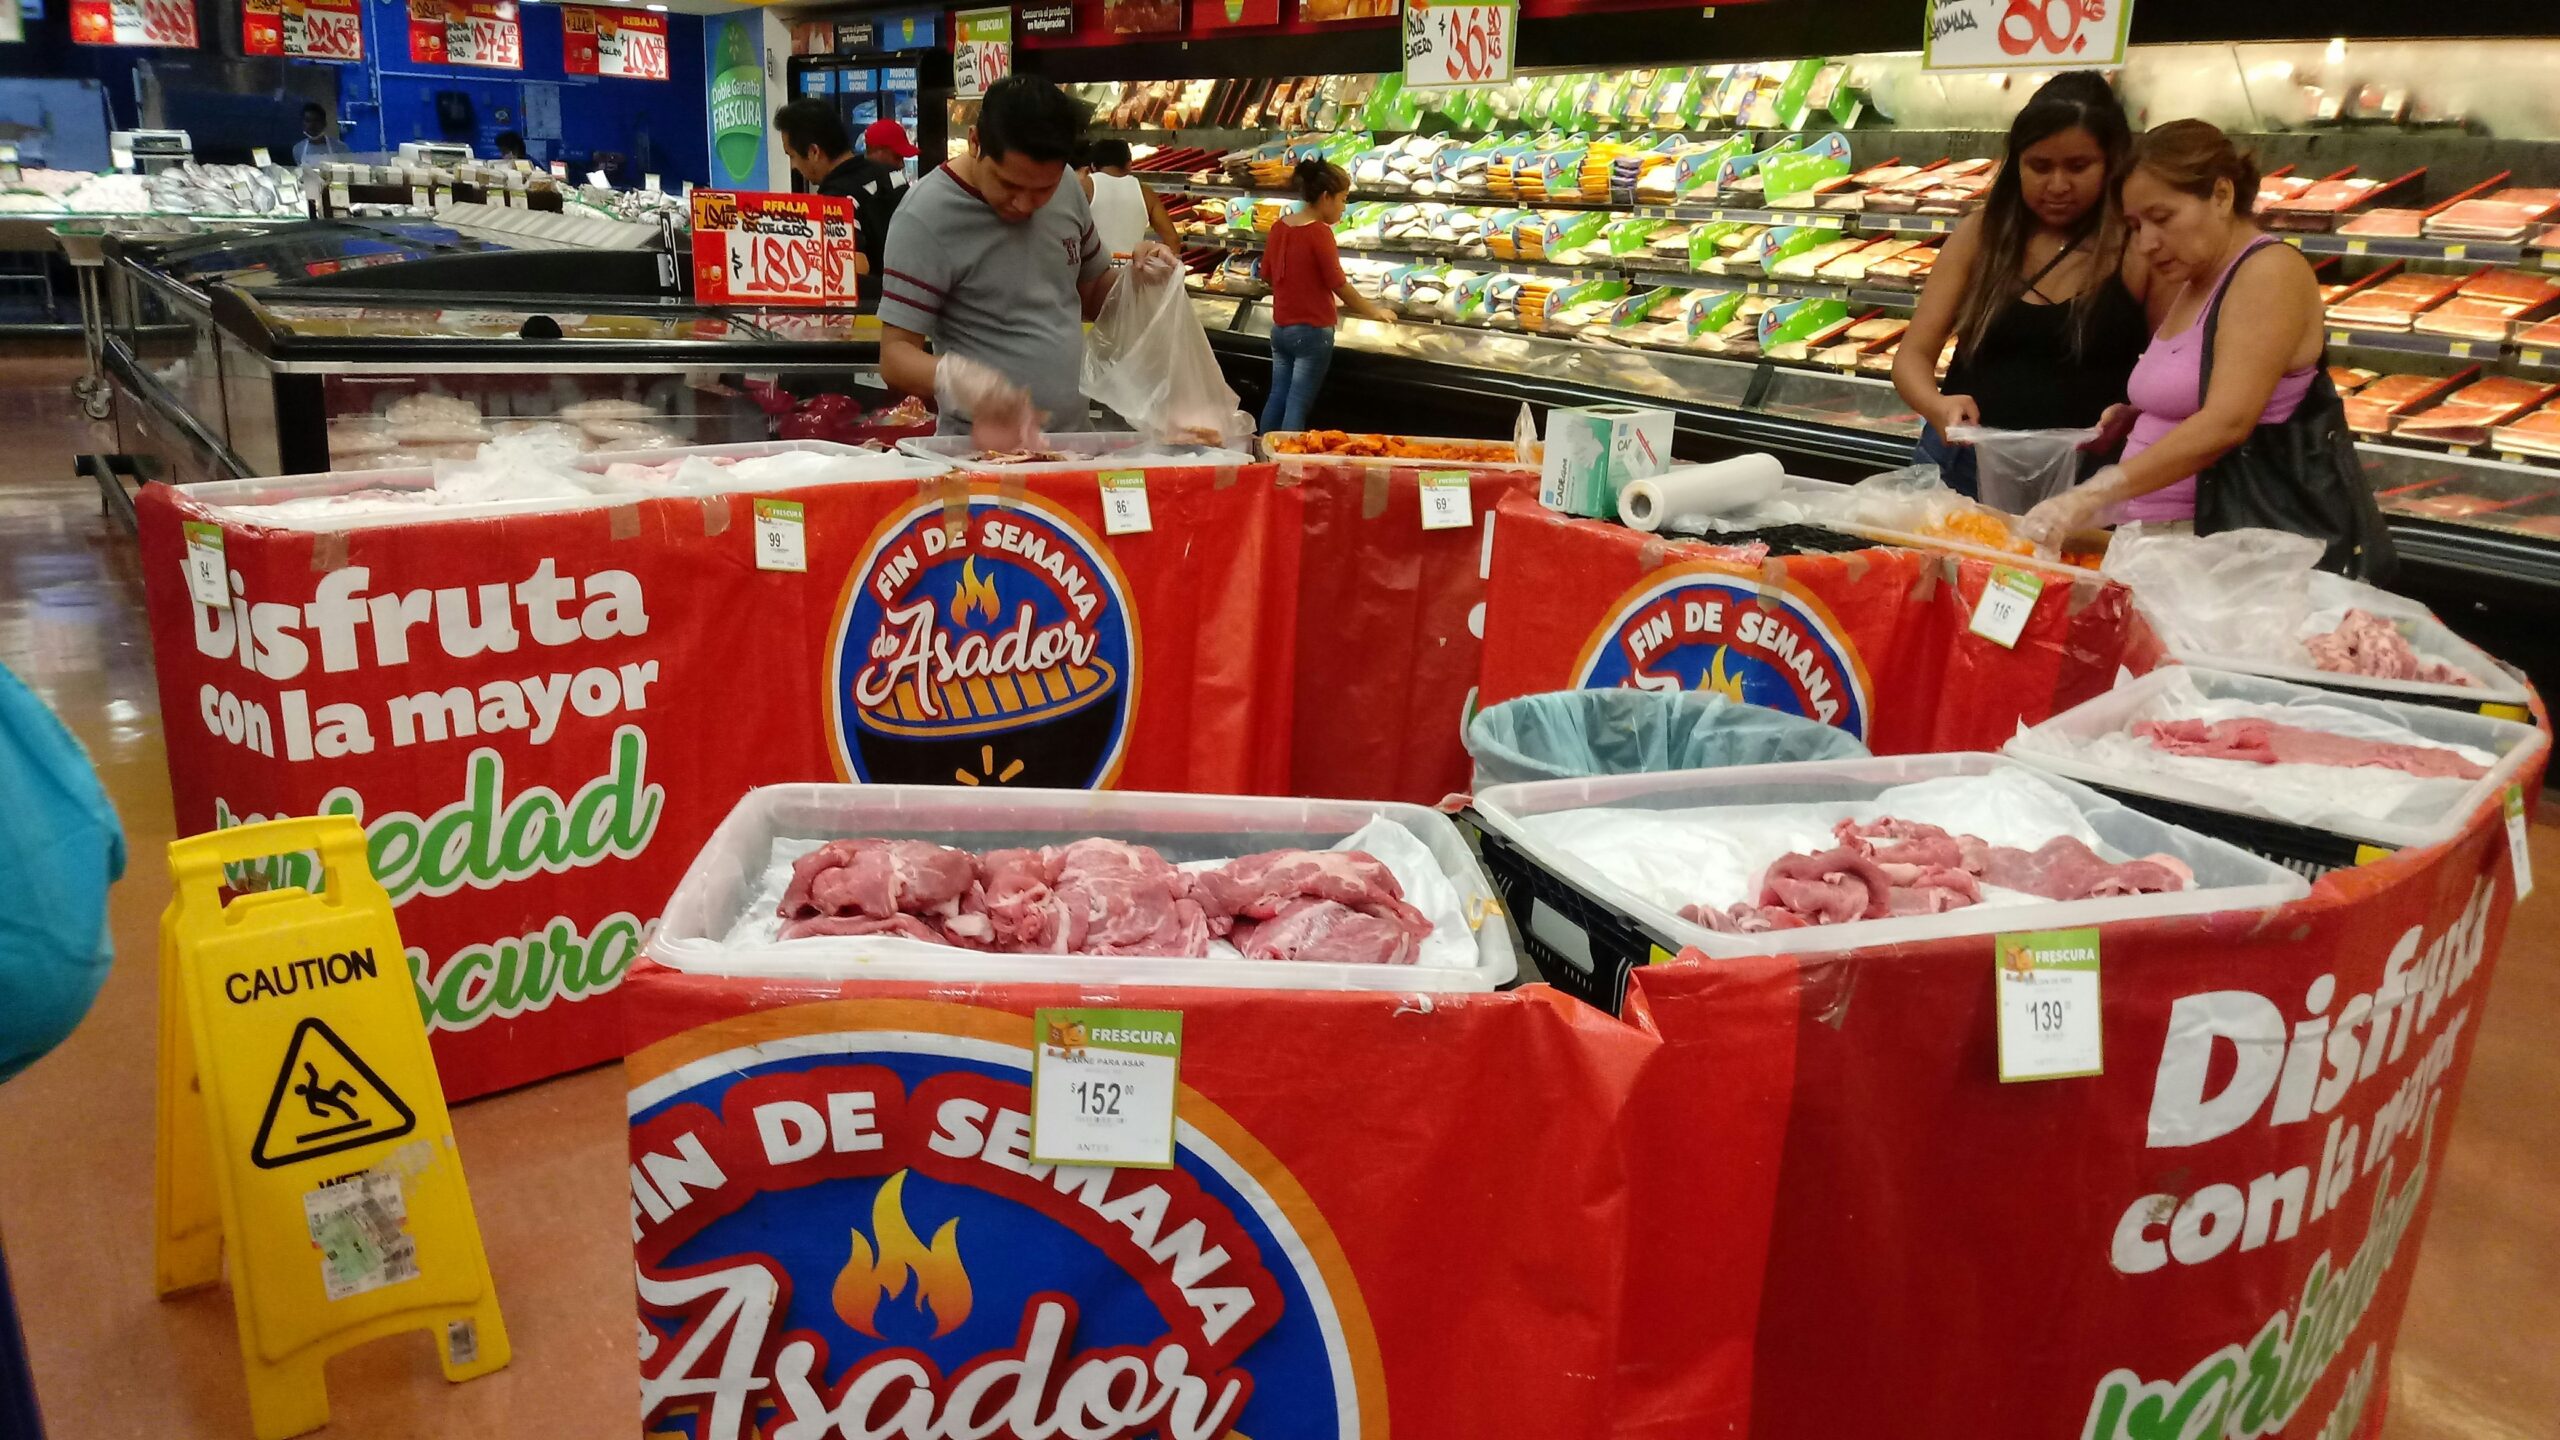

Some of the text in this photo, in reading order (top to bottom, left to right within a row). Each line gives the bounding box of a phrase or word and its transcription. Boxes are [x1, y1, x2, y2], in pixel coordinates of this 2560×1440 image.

[622, 15, 660, 29] REBAJA
[1405, 38, 1433, 60] ENTERO
[712, 81, 731, 105] Doble
[713, 100, 762, 133] FRESCURA
[762, 200, 809, 215] REBAJA
[1116, 500, 1127, 513] 86
[1436, 497, 1447, 510] 69
[769, 532, 781, 547] 99
[875, 520, 1098, 622] FIN DE SEMANA
[856, 600, 1096, 717] de Asador
[1626, 611, 1673, 662] FIN
[1684, 601, 1723, 634] DE
[1736, 610, 1839, 727] SEMANA
[200, 659, 659, 763] con la mayor
[2035, 948, 2096, 963] FRESCURA
[225, 946, 377, 1005] CAUTION
[2146, 874, 2496, 1148] Disfruta
[1091, 1027, 1176, 1046] FRESCURA
[1097, 1058, 1120, 1066] PARA
[1122, 1060, 1145, 1068] ASAR
[753, 1091, 884, 1167] DE
[2111, 1164, 2310, 1275] con
[2310, 1115, 2360, 1223] la
[633, 1262, 1243, 1440] Asador
